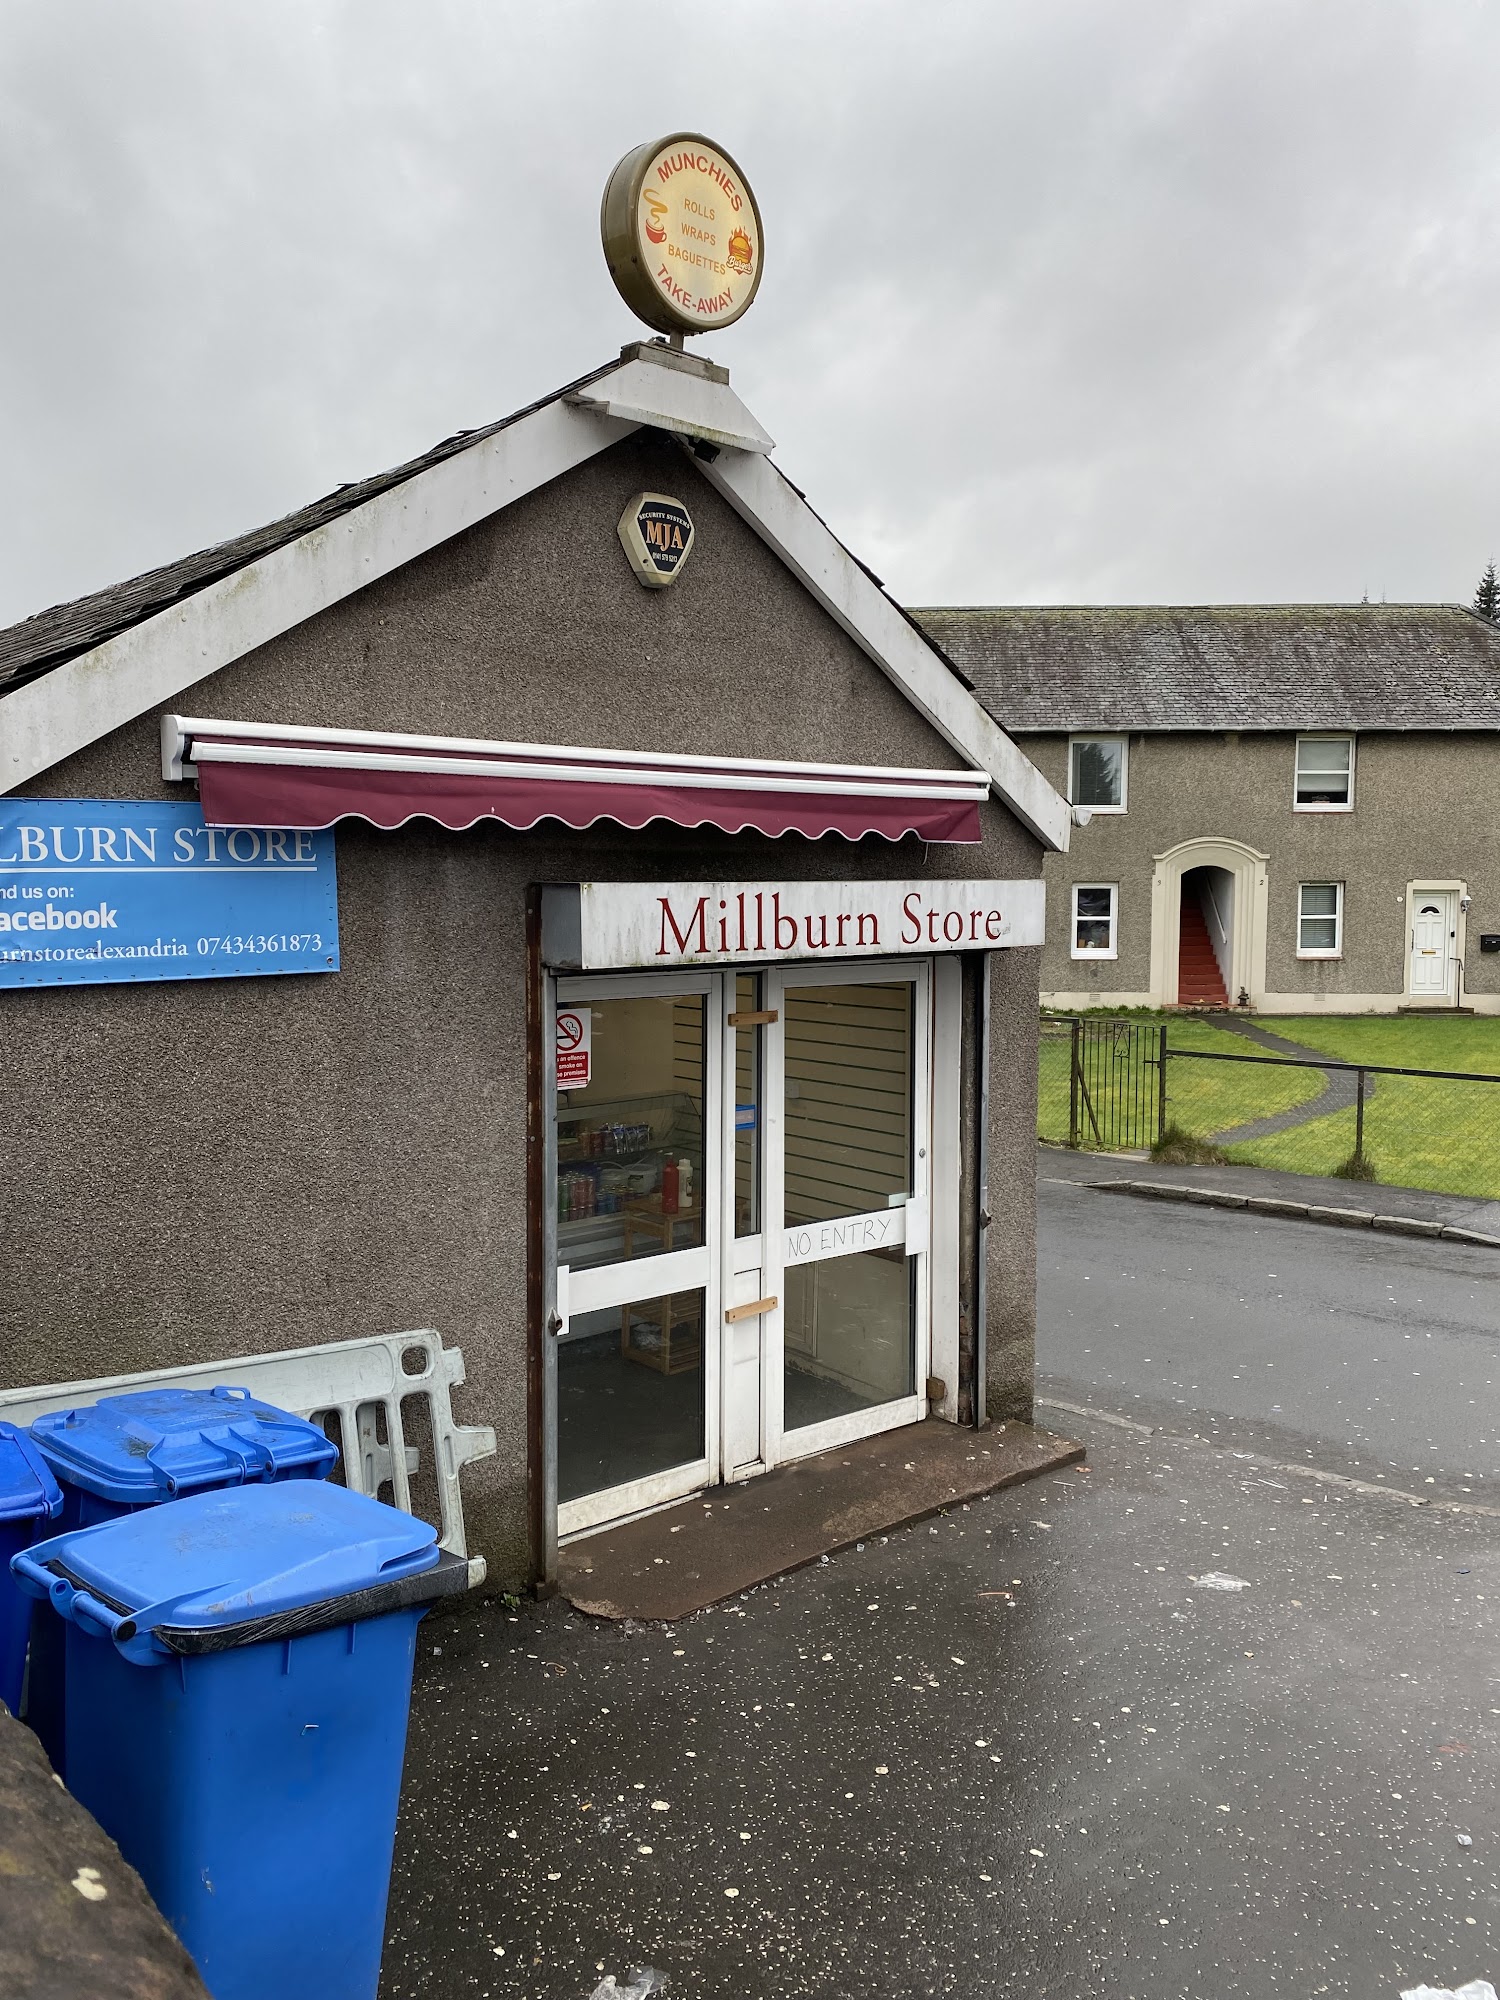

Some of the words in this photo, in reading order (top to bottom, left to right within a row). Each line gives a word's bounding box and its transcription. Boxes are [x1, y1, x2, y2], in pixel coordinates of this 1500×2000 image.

[657, 152, 743, 212] MUNCHIES
[684, 198, 716, 221] ROLLS
[681, 222, 716, 246] WRAPS
[668, 243, 726, 275] BAGUETTES
[657, 263, 735, 314] TAKE-AWAY
[638, 511, 666, 521] SECURITY
[666, 513, 690, 529] SYSTEMS
[645, 520, 684, 552] MJA
[173, 827, 318, 863] STORE
[22, 887, 43, 899] us
[47, 886, 74, 898] on:
[655, 891, 881, 955] Millburn
[901, 892, 1002, 945] Store
[197, 933, 322, 956] 07434361873
[788, 1232, 812, 1259] NO
[821, 1218, 891, 1250] ENTRY
